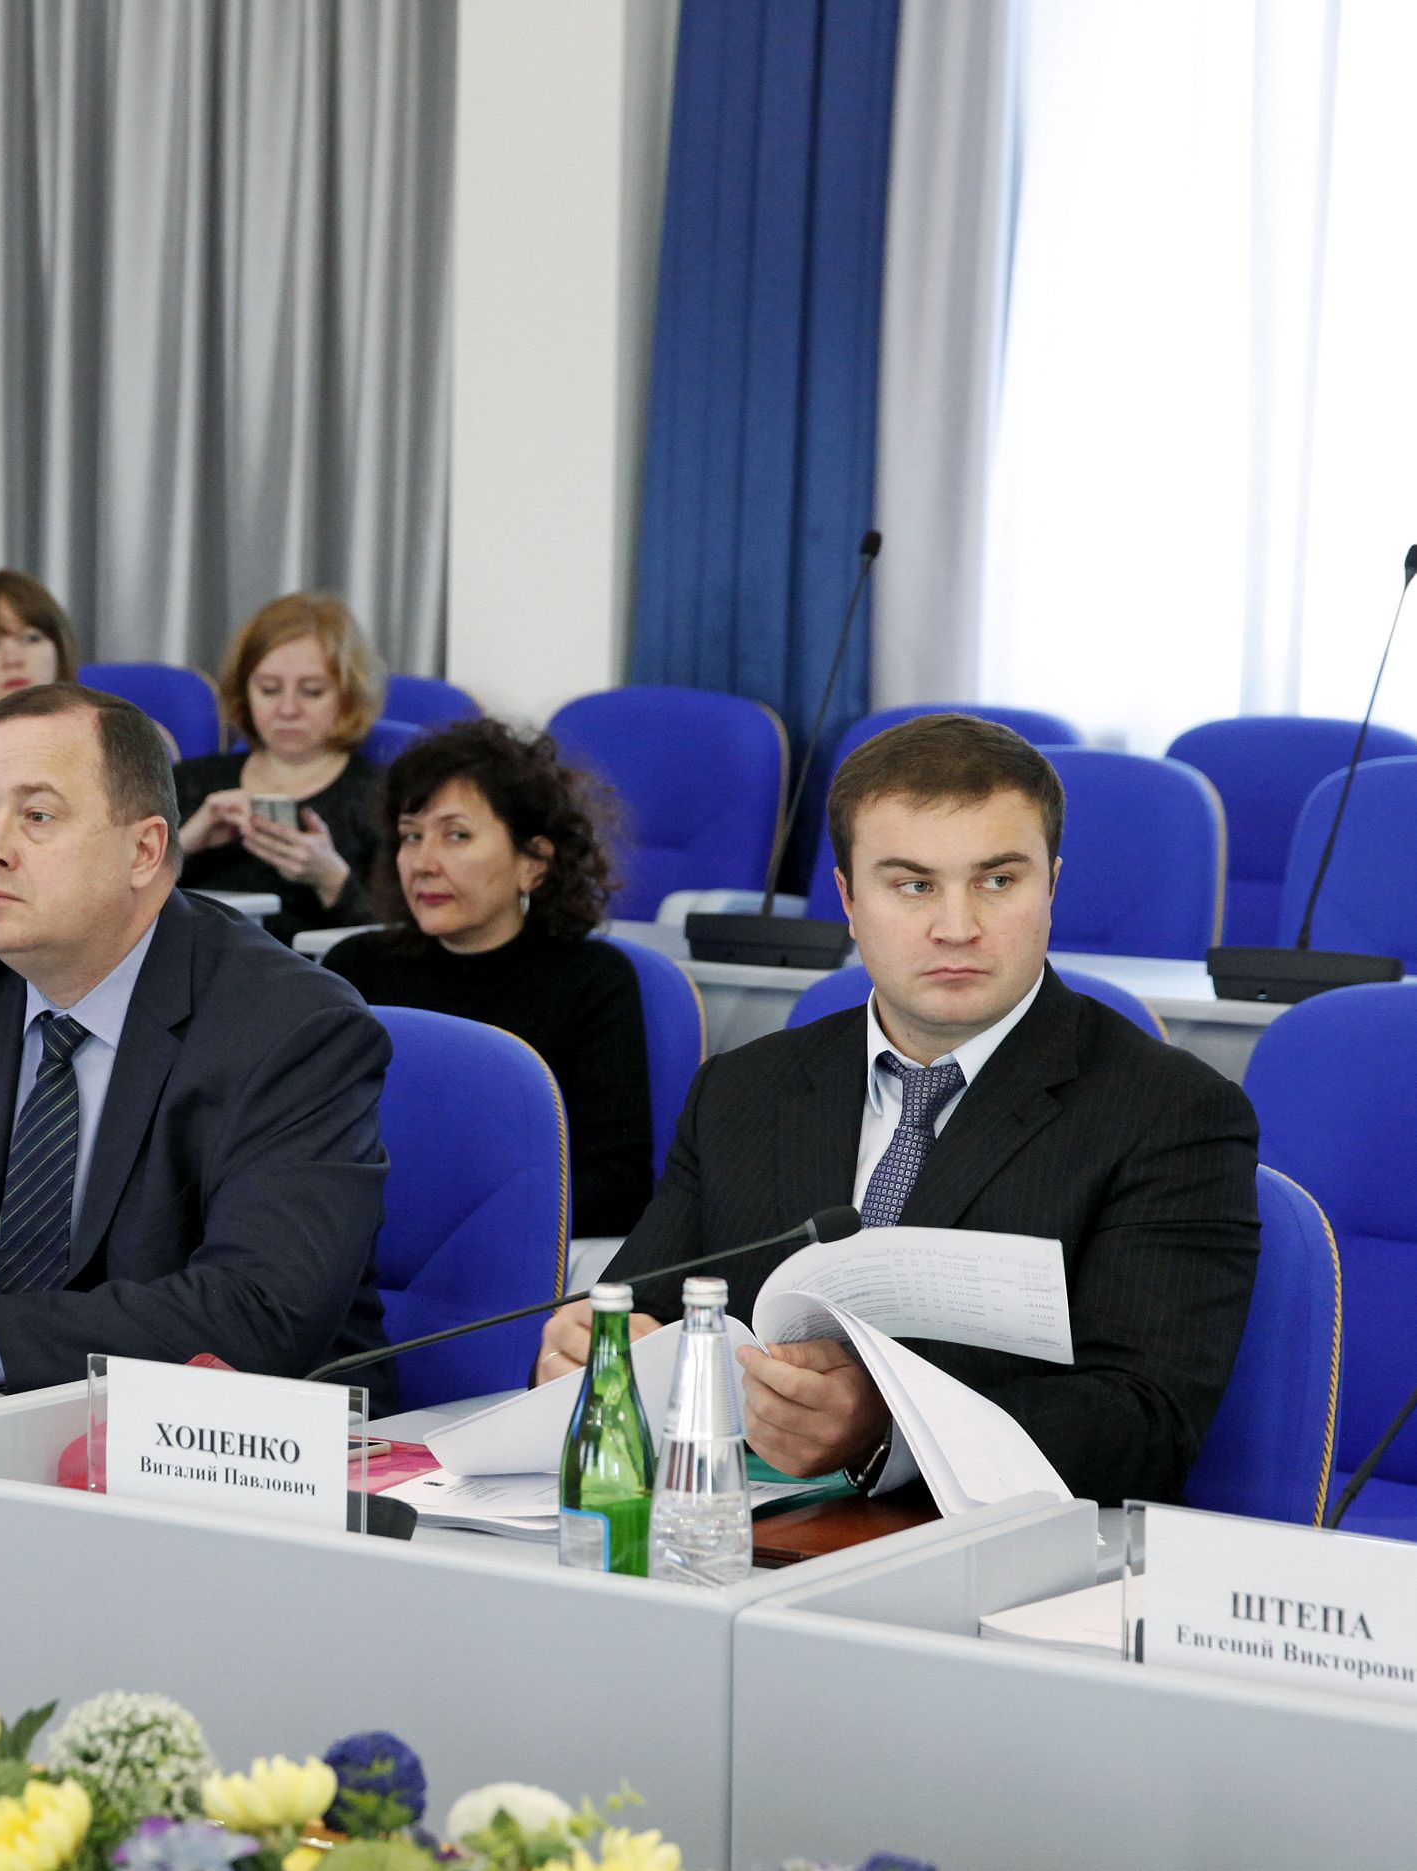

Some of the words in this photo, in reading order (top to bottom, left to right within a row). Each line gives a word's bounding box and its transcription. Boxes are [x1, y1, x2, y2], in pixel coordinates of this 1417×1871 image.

[155, 1422, 301, 1465] ХОЦЕНКО
[140, 1456, 218, 1483] Виталий
[224, 1467, 316, 1497] Павлович
[1231, 1590, 1375, 1641] ШТЕПА
[1176, 1623, 1274, 1660] Евгений
